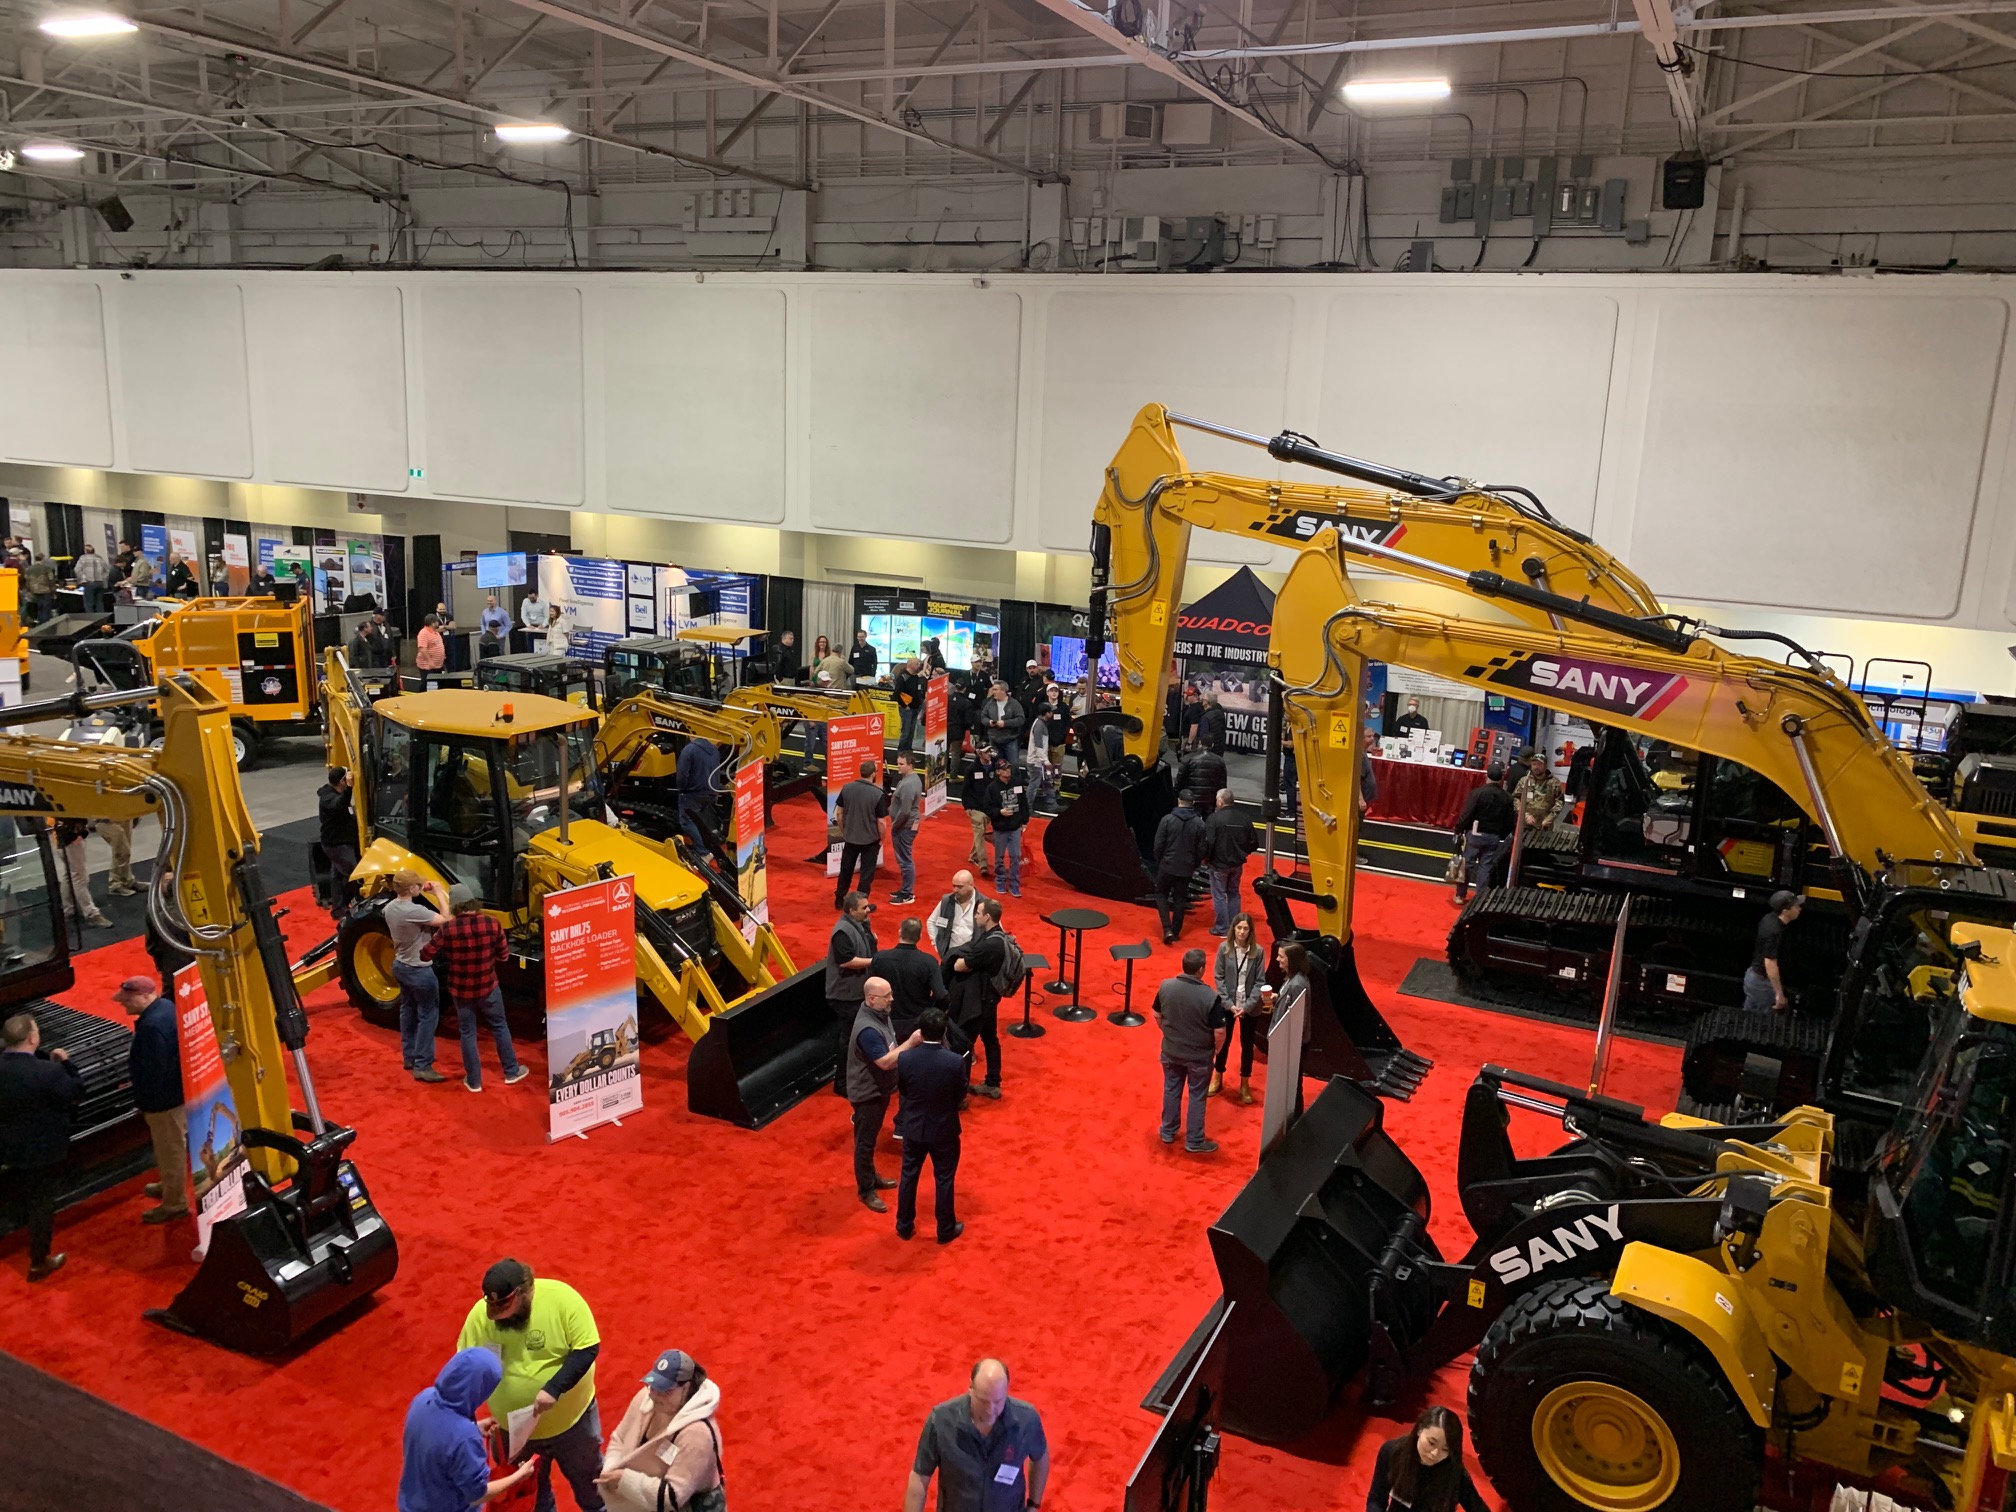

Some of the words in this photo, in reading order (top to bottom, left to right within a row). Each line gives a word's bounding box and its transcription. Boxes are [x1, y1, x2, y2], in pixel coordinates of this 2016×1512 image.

[635, 605, 647, 614] Bell
[927, 601, 971, 612] EQUIPMENT
[927, 607, 963, 616] JOURNAL
[678, 620, 698, 629] LVM
[1195, 644, 1205, 656] IN
[1206, 645, 1223, 659] THE
[1225, 647, 1268, 663] INDUSTRY
[1529, 660, 1652, 705] SANY
[654, 716, 683, 730] SANY
[1224, 712, 1249, 730] EW
[1252, 717, 1268, 733] GE
[1225, 730, 1259, 750] TTING
[842, 746, 870, 755] EXCAVATOR
[612, 901, 632, 912] SANY
[675, 908, 697, 924] SANY
[550, 927, 569, 944] SANY
[550, 937, 586, 954] BACKHOE
[587, 929, 618, 943] LOADER
[555, 1083, 579, 1104] EVERY
[579, 1073, 608, 1095] DOLLAR
[608, 1063, 636, 1084] COUNTS
[1490, 1203, 1624, 1285] SANY
